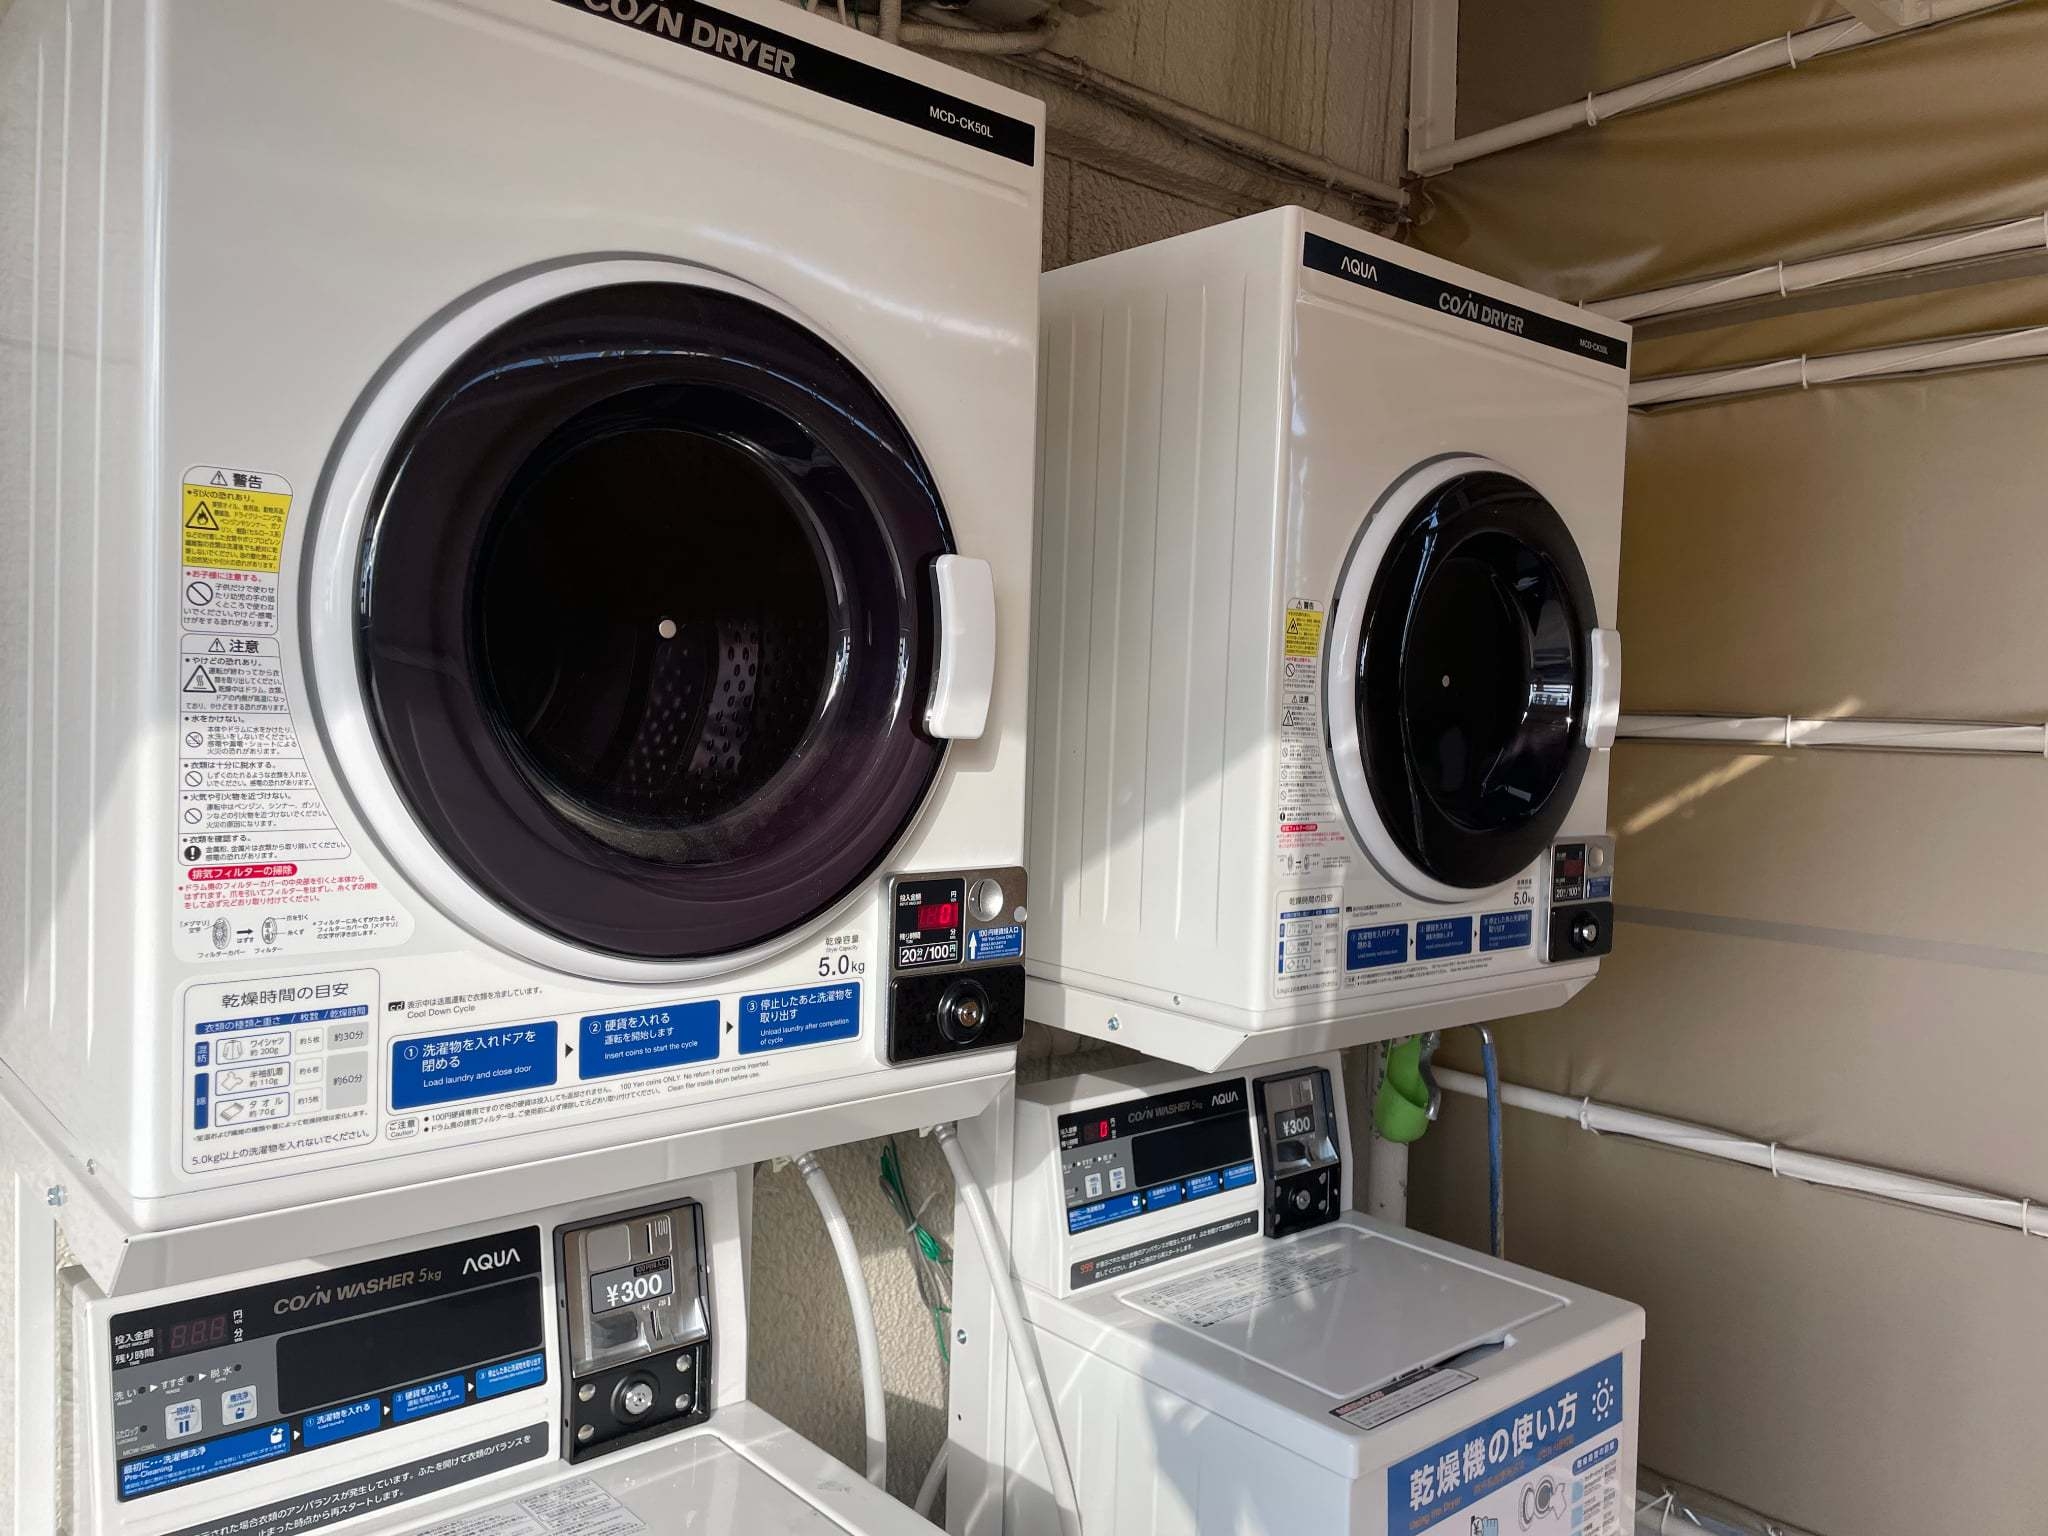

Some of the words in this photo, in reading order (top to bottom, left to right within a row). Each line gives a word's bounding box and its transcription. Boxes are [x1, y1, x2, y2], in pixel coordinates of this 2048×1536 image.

[691, 18, 796, 78] DRYER
[929, 105, 994, 138] MCD-CK50L
[1341, 255, 1378, 282] AQUA
[1439, 292, 1479, 320] COIN
[1481, 305, 1524, 334] DRYER
[233, 473, 263, 489] 警告
[229, 639, 259, 653] 注意
[221, 983, 350, 1009] 乾燥時間の目安
[760, 988, 853, 1012] 停止したあと洗濯物を
[407, 1009, 426, 1019] Cool
[428, 1006, 452, 1017] Down
[453, 1003, 476, 1015] Cycle
[760, 1008, 798, 1024] 取り出す
[604, 1012, 671, 1032] 硬貨を入れる
[780, 1024, 803, 1036] laundry
[804, 1022, 818, 1031] after
[422, 1030, 537, 1058] 洗濯物を入れドアを
[604, 1026, 675, 1046] 運転を開始します
[767, 1036, 784, 1046] cycle
[625, 1048, 643, 1058] coins
[644, 1047, 652, 1055] to
[653, 1044, 668, 1054] start
[669, 1041, 680, 1051] the
[680, 1039, 699, 1051] cycle
[421, 1055, 461, 1073] 閉める
[423, 1076, 444, 1088] Load
[445, 1073, 475, 1087] laundry
[476, 1069, 491, 1080] and
[492, 1066, 513, 1078] close
[514, 1064, 532, 1075] door
[1211, 1091, 1239, 1107] AQUA
[1282, 1116, 1311, 1136] ¥300
[462, 1247, 521, 1275] AQUA
[273, 1284, 331, 1315] COIN
[336, 1269, 415, 1301] WASHER
[417, 1267, 443, 1283] 5kg
[606, 1273, 663, 1307] ¥300
[233, 1309, 243, 1320] 円
[114, 1328, 154, 1346] 投入金額
[233, 1327, 244, 1338] 分
[114, 1347, 155, 1364] 残り時間
[161, 1376, 185, 1389] すすぎ
[316, 1403, 371, 1425] 洗濯物を入れる
[1409, 1391, 1579, 1512] 乾燥機の使い方
[193, 1433, 532, 1536] 示された場合衣類のアンバランスが発生しています。ふたを開けて衣類のバランスを
